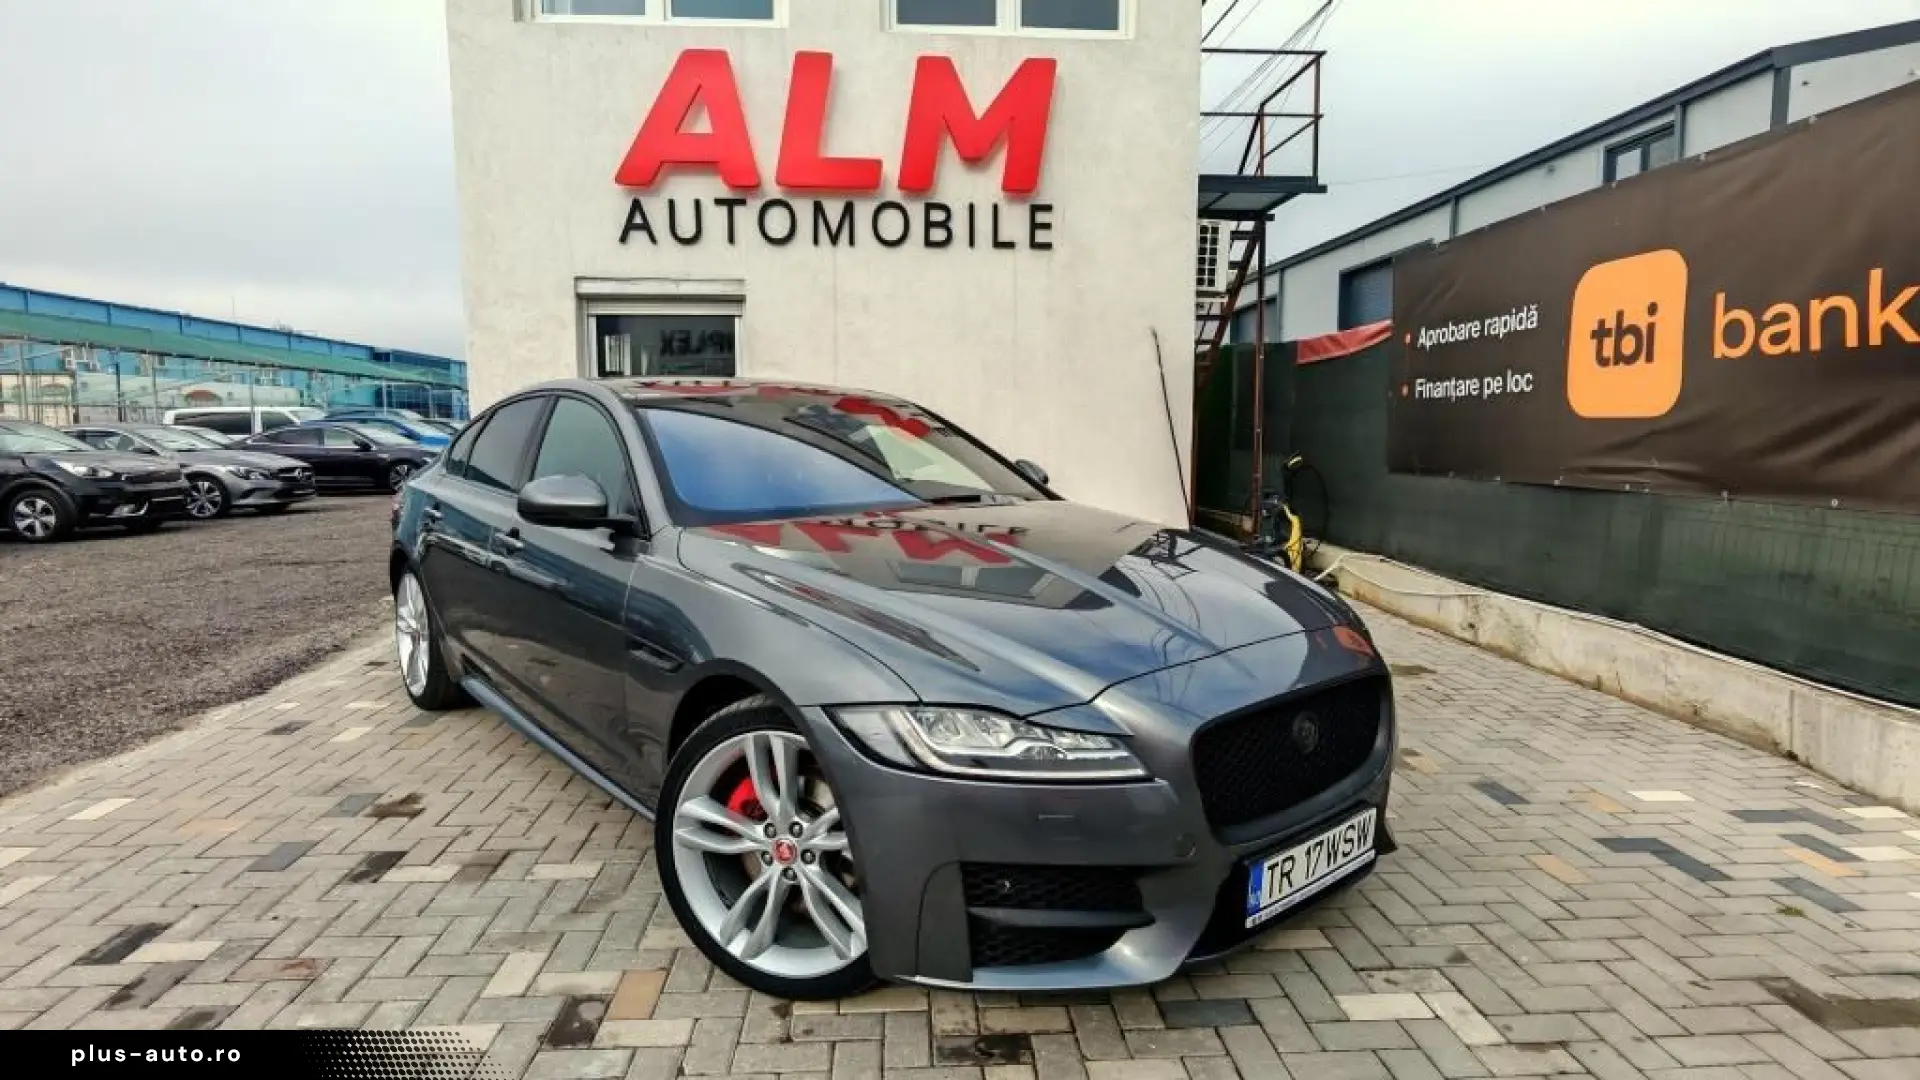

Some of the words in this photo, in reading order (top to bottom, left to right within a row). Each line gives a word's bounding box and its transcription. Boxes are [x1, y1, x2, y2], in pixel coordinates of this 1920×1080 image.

[614, 48, 1058, 194] ALM
[618, 198, 1054, 251] AUTOMOBILE
[1417, 321, 1482, 352] Aprobare
[1484, 303, 1539, 339] rapidă
[1590, 301, 1659, 367] tbi
[1713, 267, 1920, 359] bank
[1483, 376, 1503, 399] pe
[1507, 368, 1533, 393] loc
[1267, 854, 1296, 899] TR
[1305, 839, 1324, 880] 17
[1327, 815, 1372, 869] WSW
